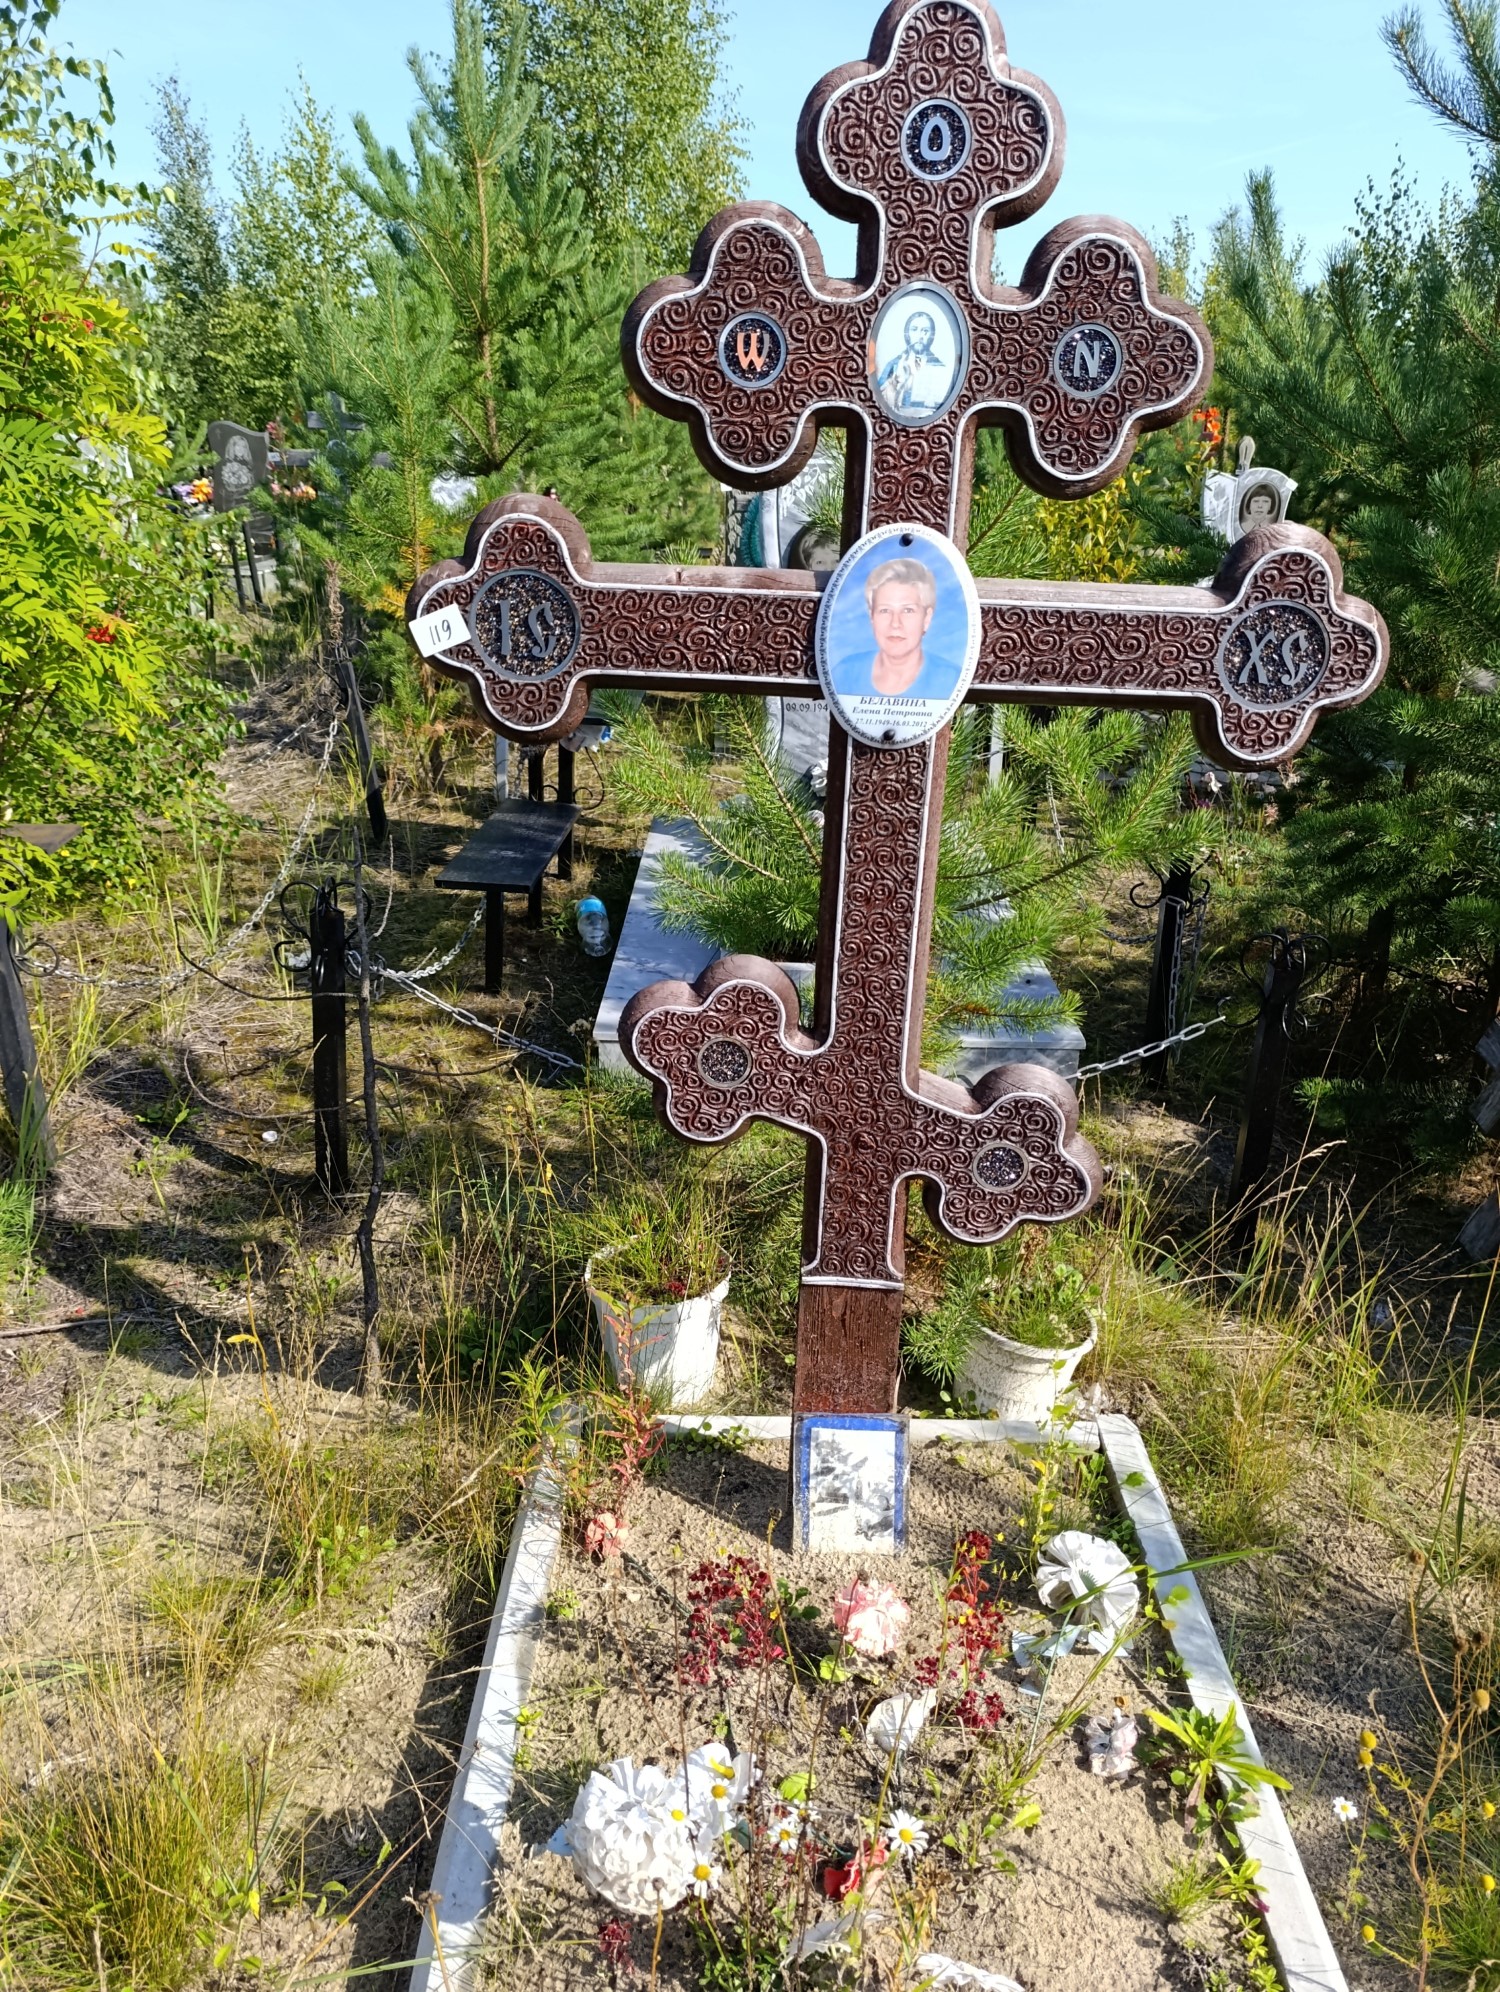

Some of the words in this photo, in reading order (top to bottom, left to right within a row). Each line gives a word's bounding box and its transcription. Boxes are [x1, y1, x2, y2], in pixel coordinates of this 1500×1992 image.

[429, 619, 452, 646] 119
[785, 702, 829, 713] 09.09.194
[859, 696, 927, 708] БЕЛАВИНА
[852, 706, 881, 715] Елена
[883, 708, 933, 718] Петровна
